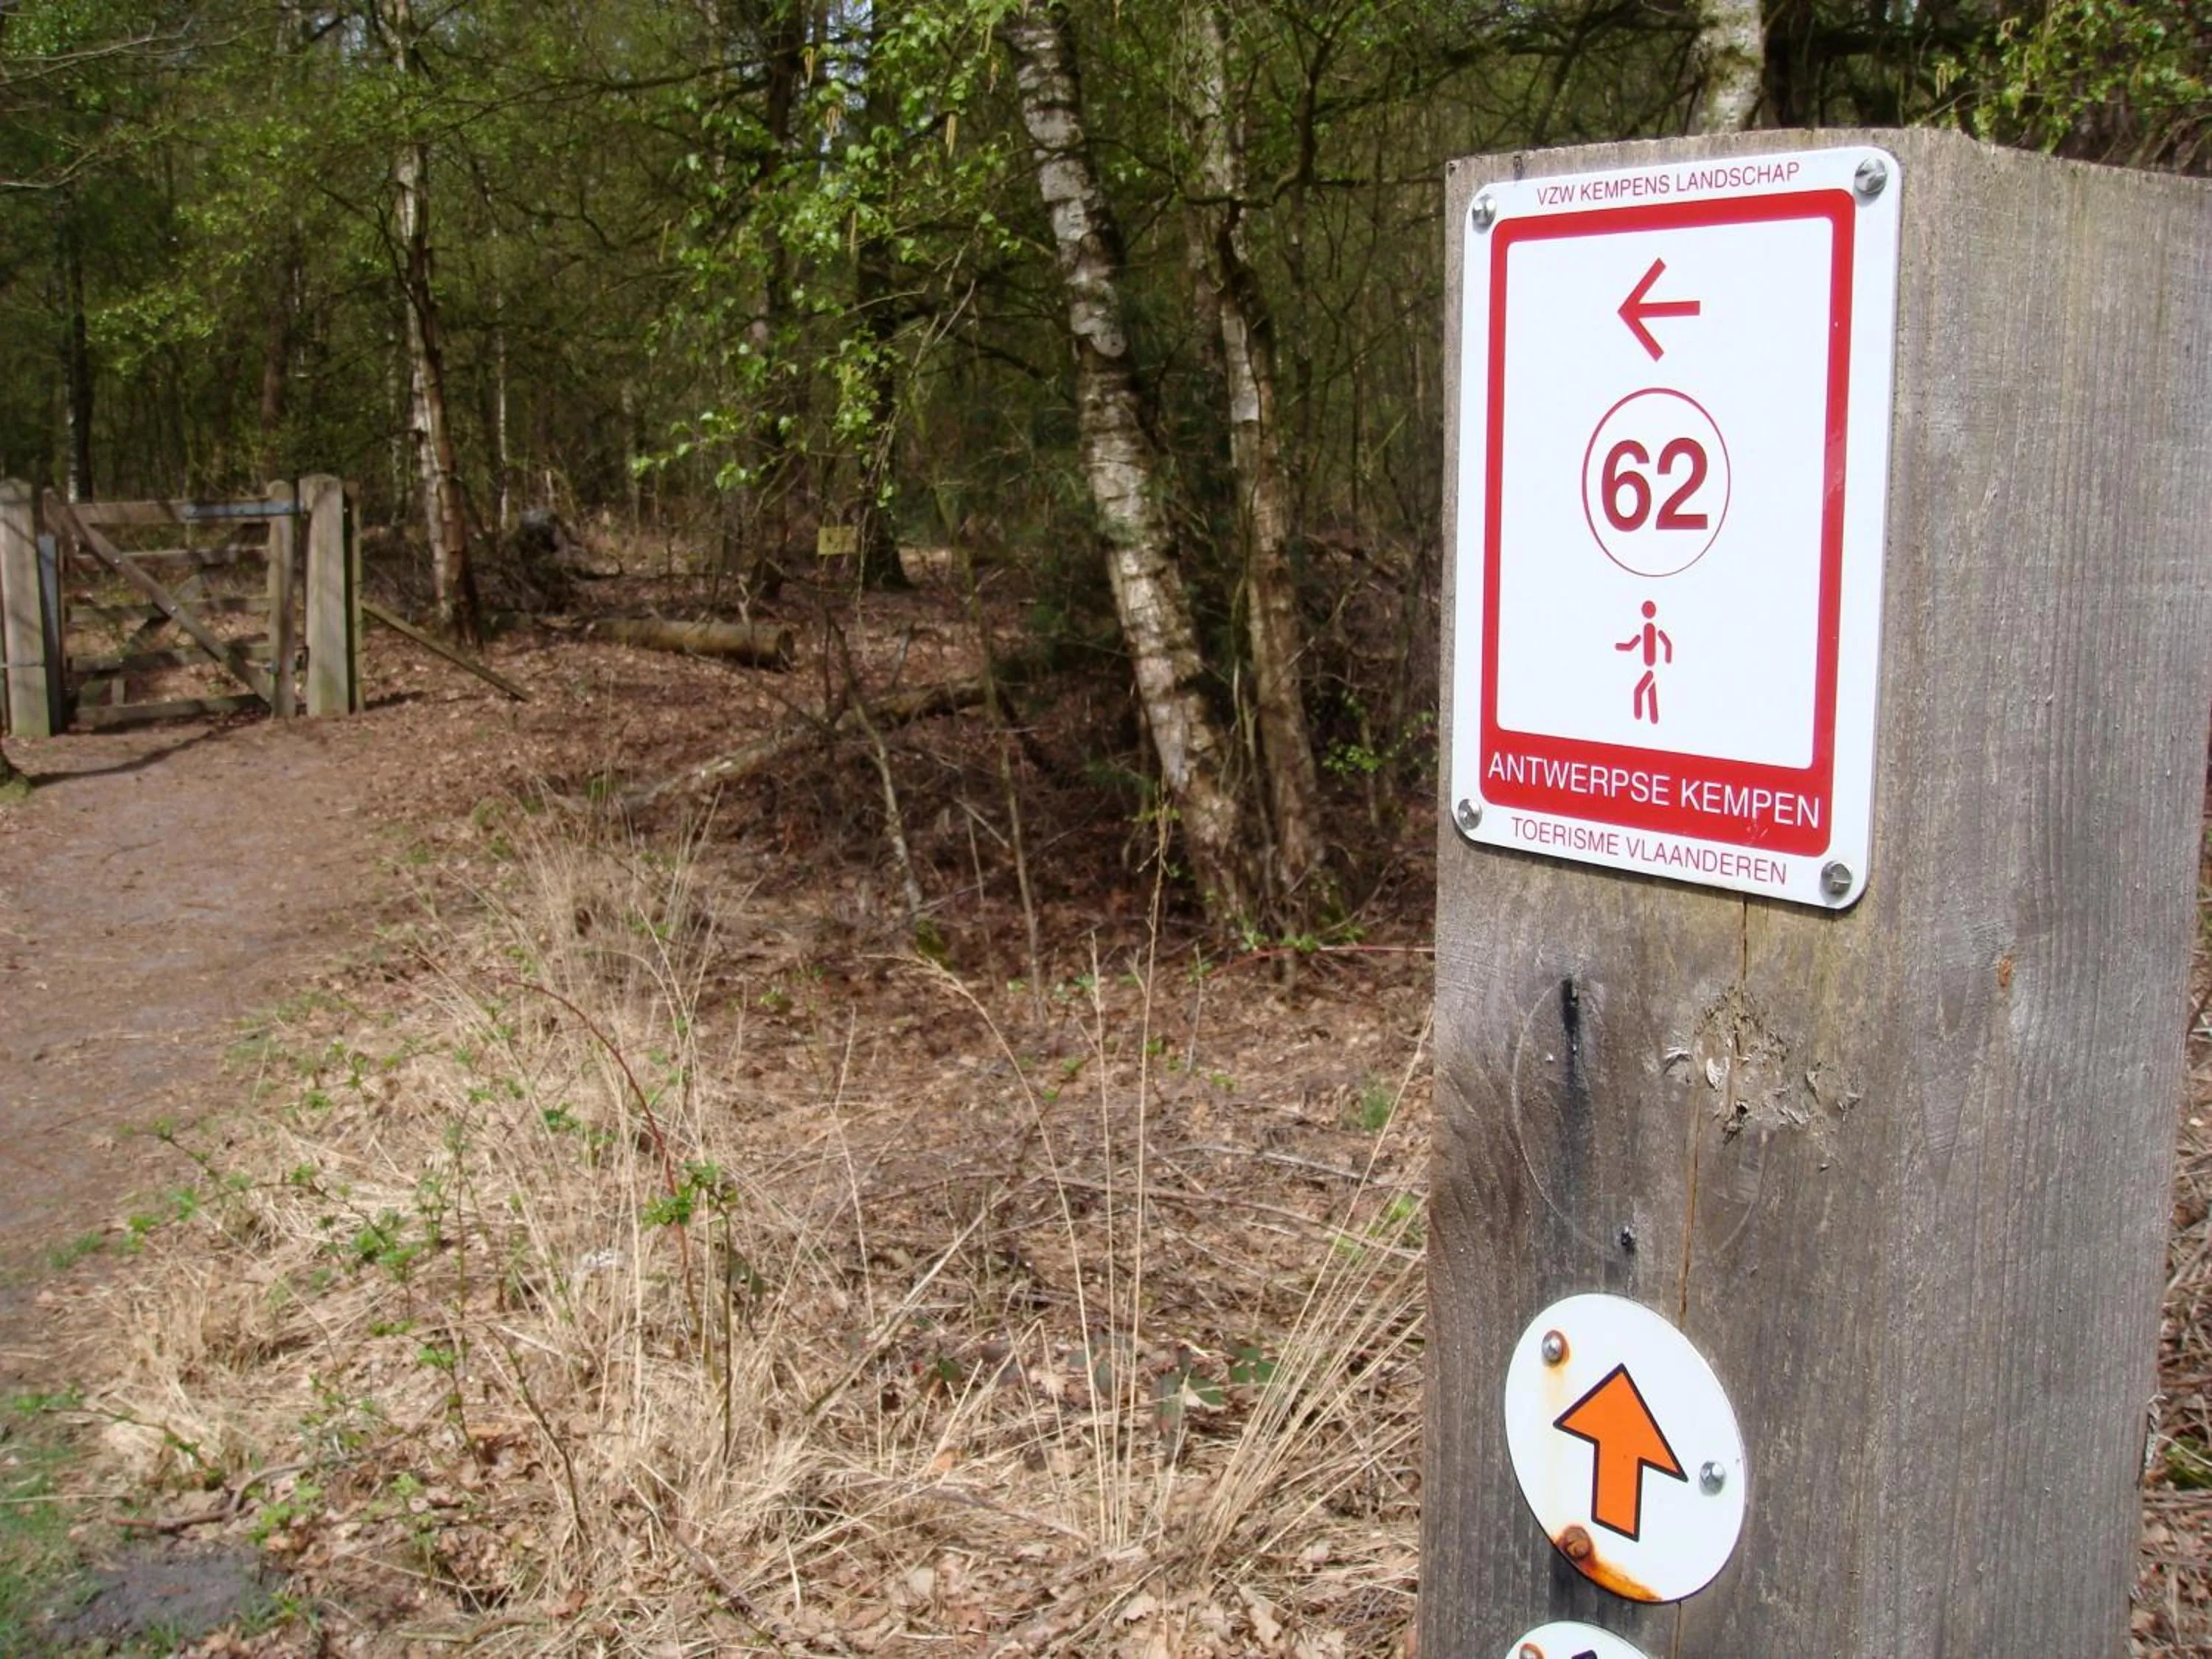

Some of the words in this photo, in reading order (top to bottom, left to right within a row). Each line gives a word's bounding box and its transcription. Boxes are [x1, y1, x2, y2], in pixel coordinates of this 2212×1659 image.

[1537, 185, 1575, 206] VZW
[1580, 175, 1669, 200] KEMPENS
[1675, 161, 1800, 192] LANDSCHAP
[1601, 437, 1708, 532] 62
[1488, 752, 1669, 805] ANTWERPSE
[1680, 779, 1820, 828] KEMPEN
[1511, 816, 1618, 855] TOERISME
[1626, 837, 1787, 884] VLAANDEREN
